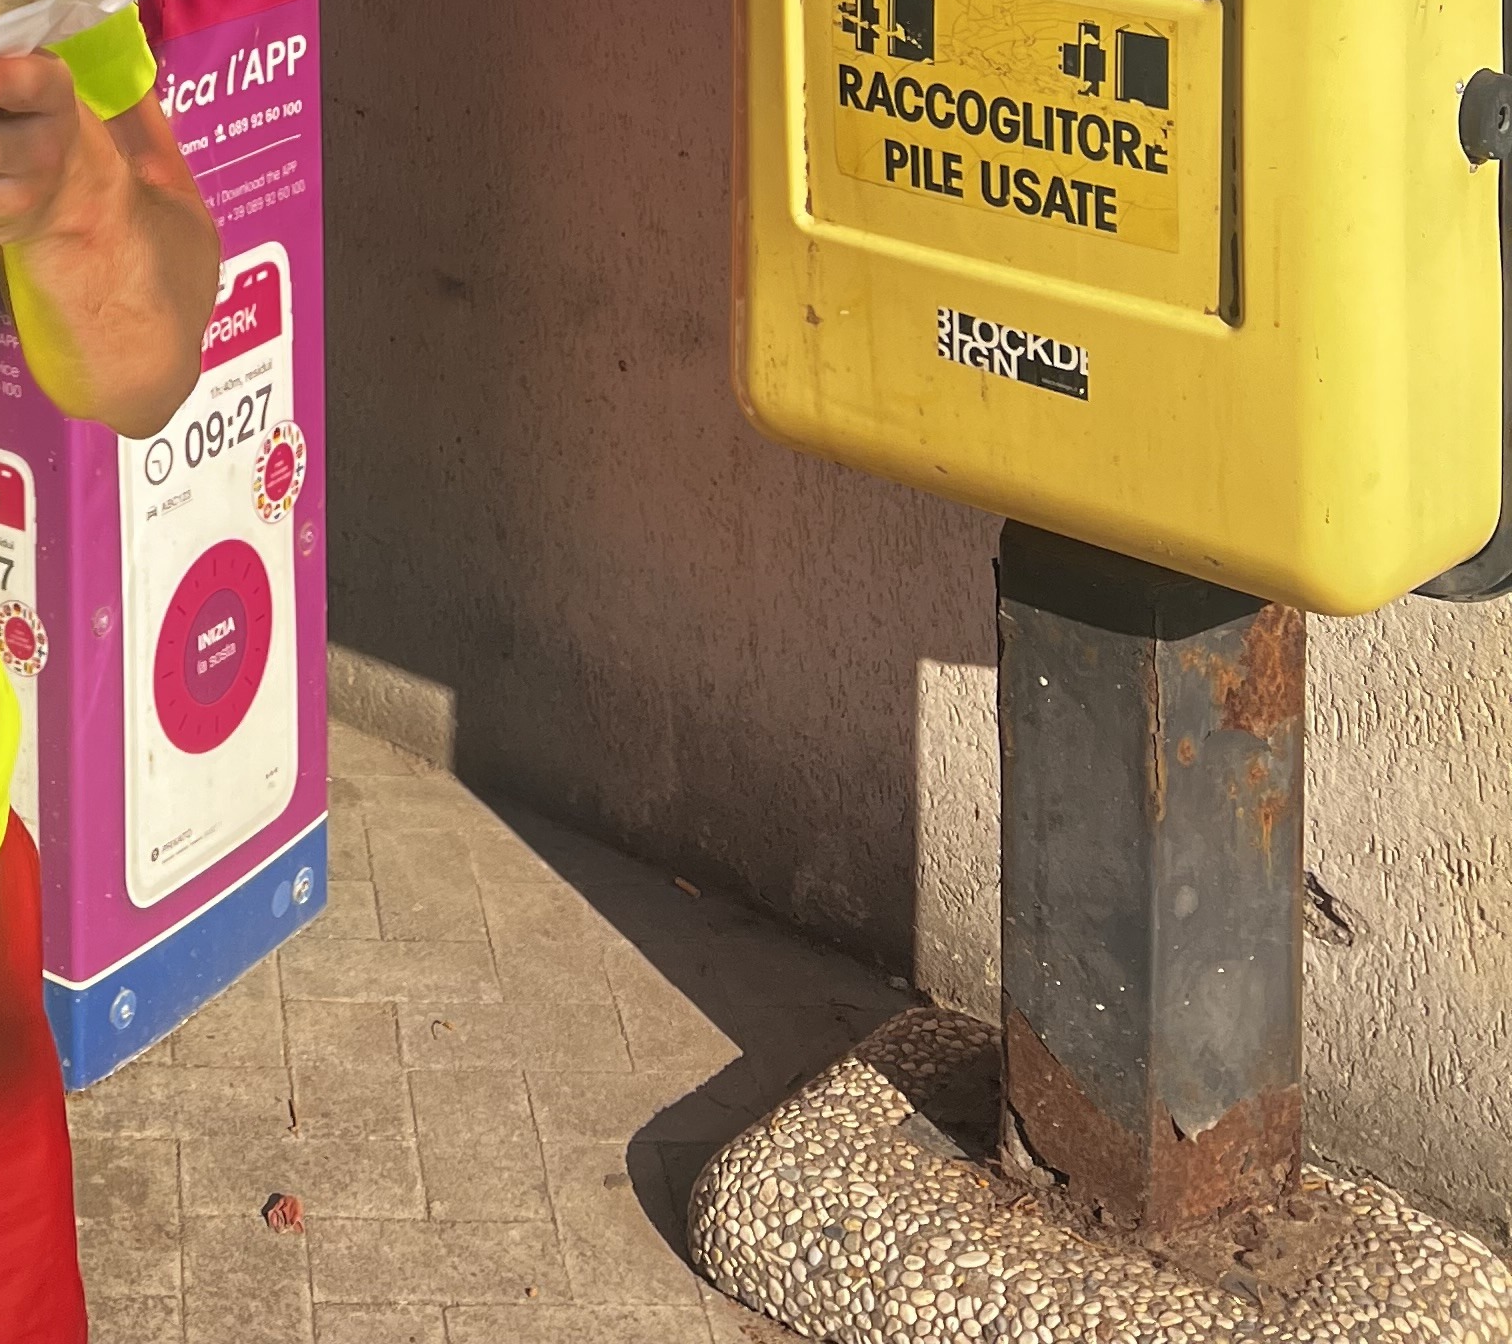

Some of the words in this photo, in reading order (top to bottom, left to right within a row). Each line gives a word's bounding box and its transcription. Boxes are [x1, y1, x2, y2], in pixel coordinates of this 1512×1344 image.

[226, 34, 307, 96] l'APP
[228, 117, 249, 137] 089
[251, 112, 264, 128] 92
[265, 106, 280, 123] 60
[283, 99, 303, 117] 100
[838, 63, 1169, 174] RACCOGLITORE
[884, 138, 964, 198] PILE
[980, 159, 1117, 233] USATE
[185, 383, 273, 468] 09:27
[197, 616, 236, 652] INIZIA
[208, 642, 237, 669] sosta
